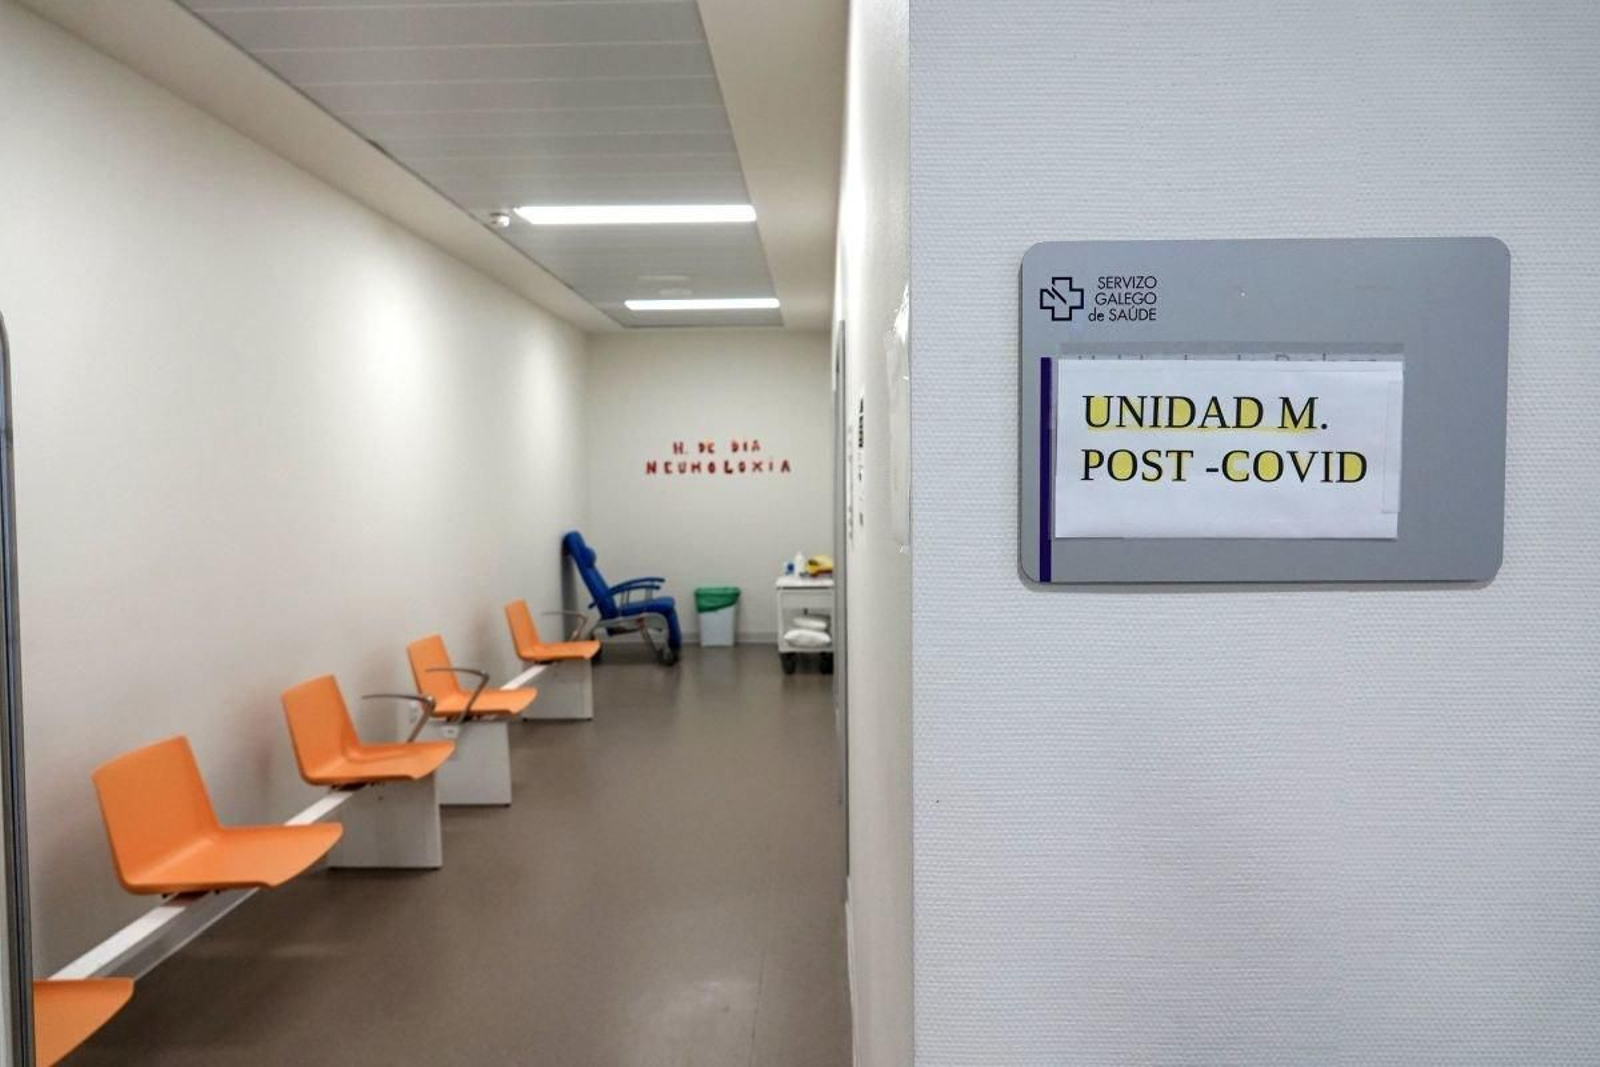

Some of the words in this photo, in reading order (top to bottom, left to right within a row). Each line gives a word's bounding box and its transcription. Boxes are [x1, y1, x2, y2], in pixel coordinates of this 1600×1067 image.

[1097, 275, 1158, 289] SERVIZO
[1094, 291, 1158, 306] GALEGO
[1088, 307, 1105, 322] de
[1108, 305, 1157, 322] SAÚDE
[1082, 394, 1264, 429] UNIDAD
[1277, 396, 1329, 430] M.
[1080, 448, 1194, 482] POST
[1205, 449, 1368, 484] -COVID
